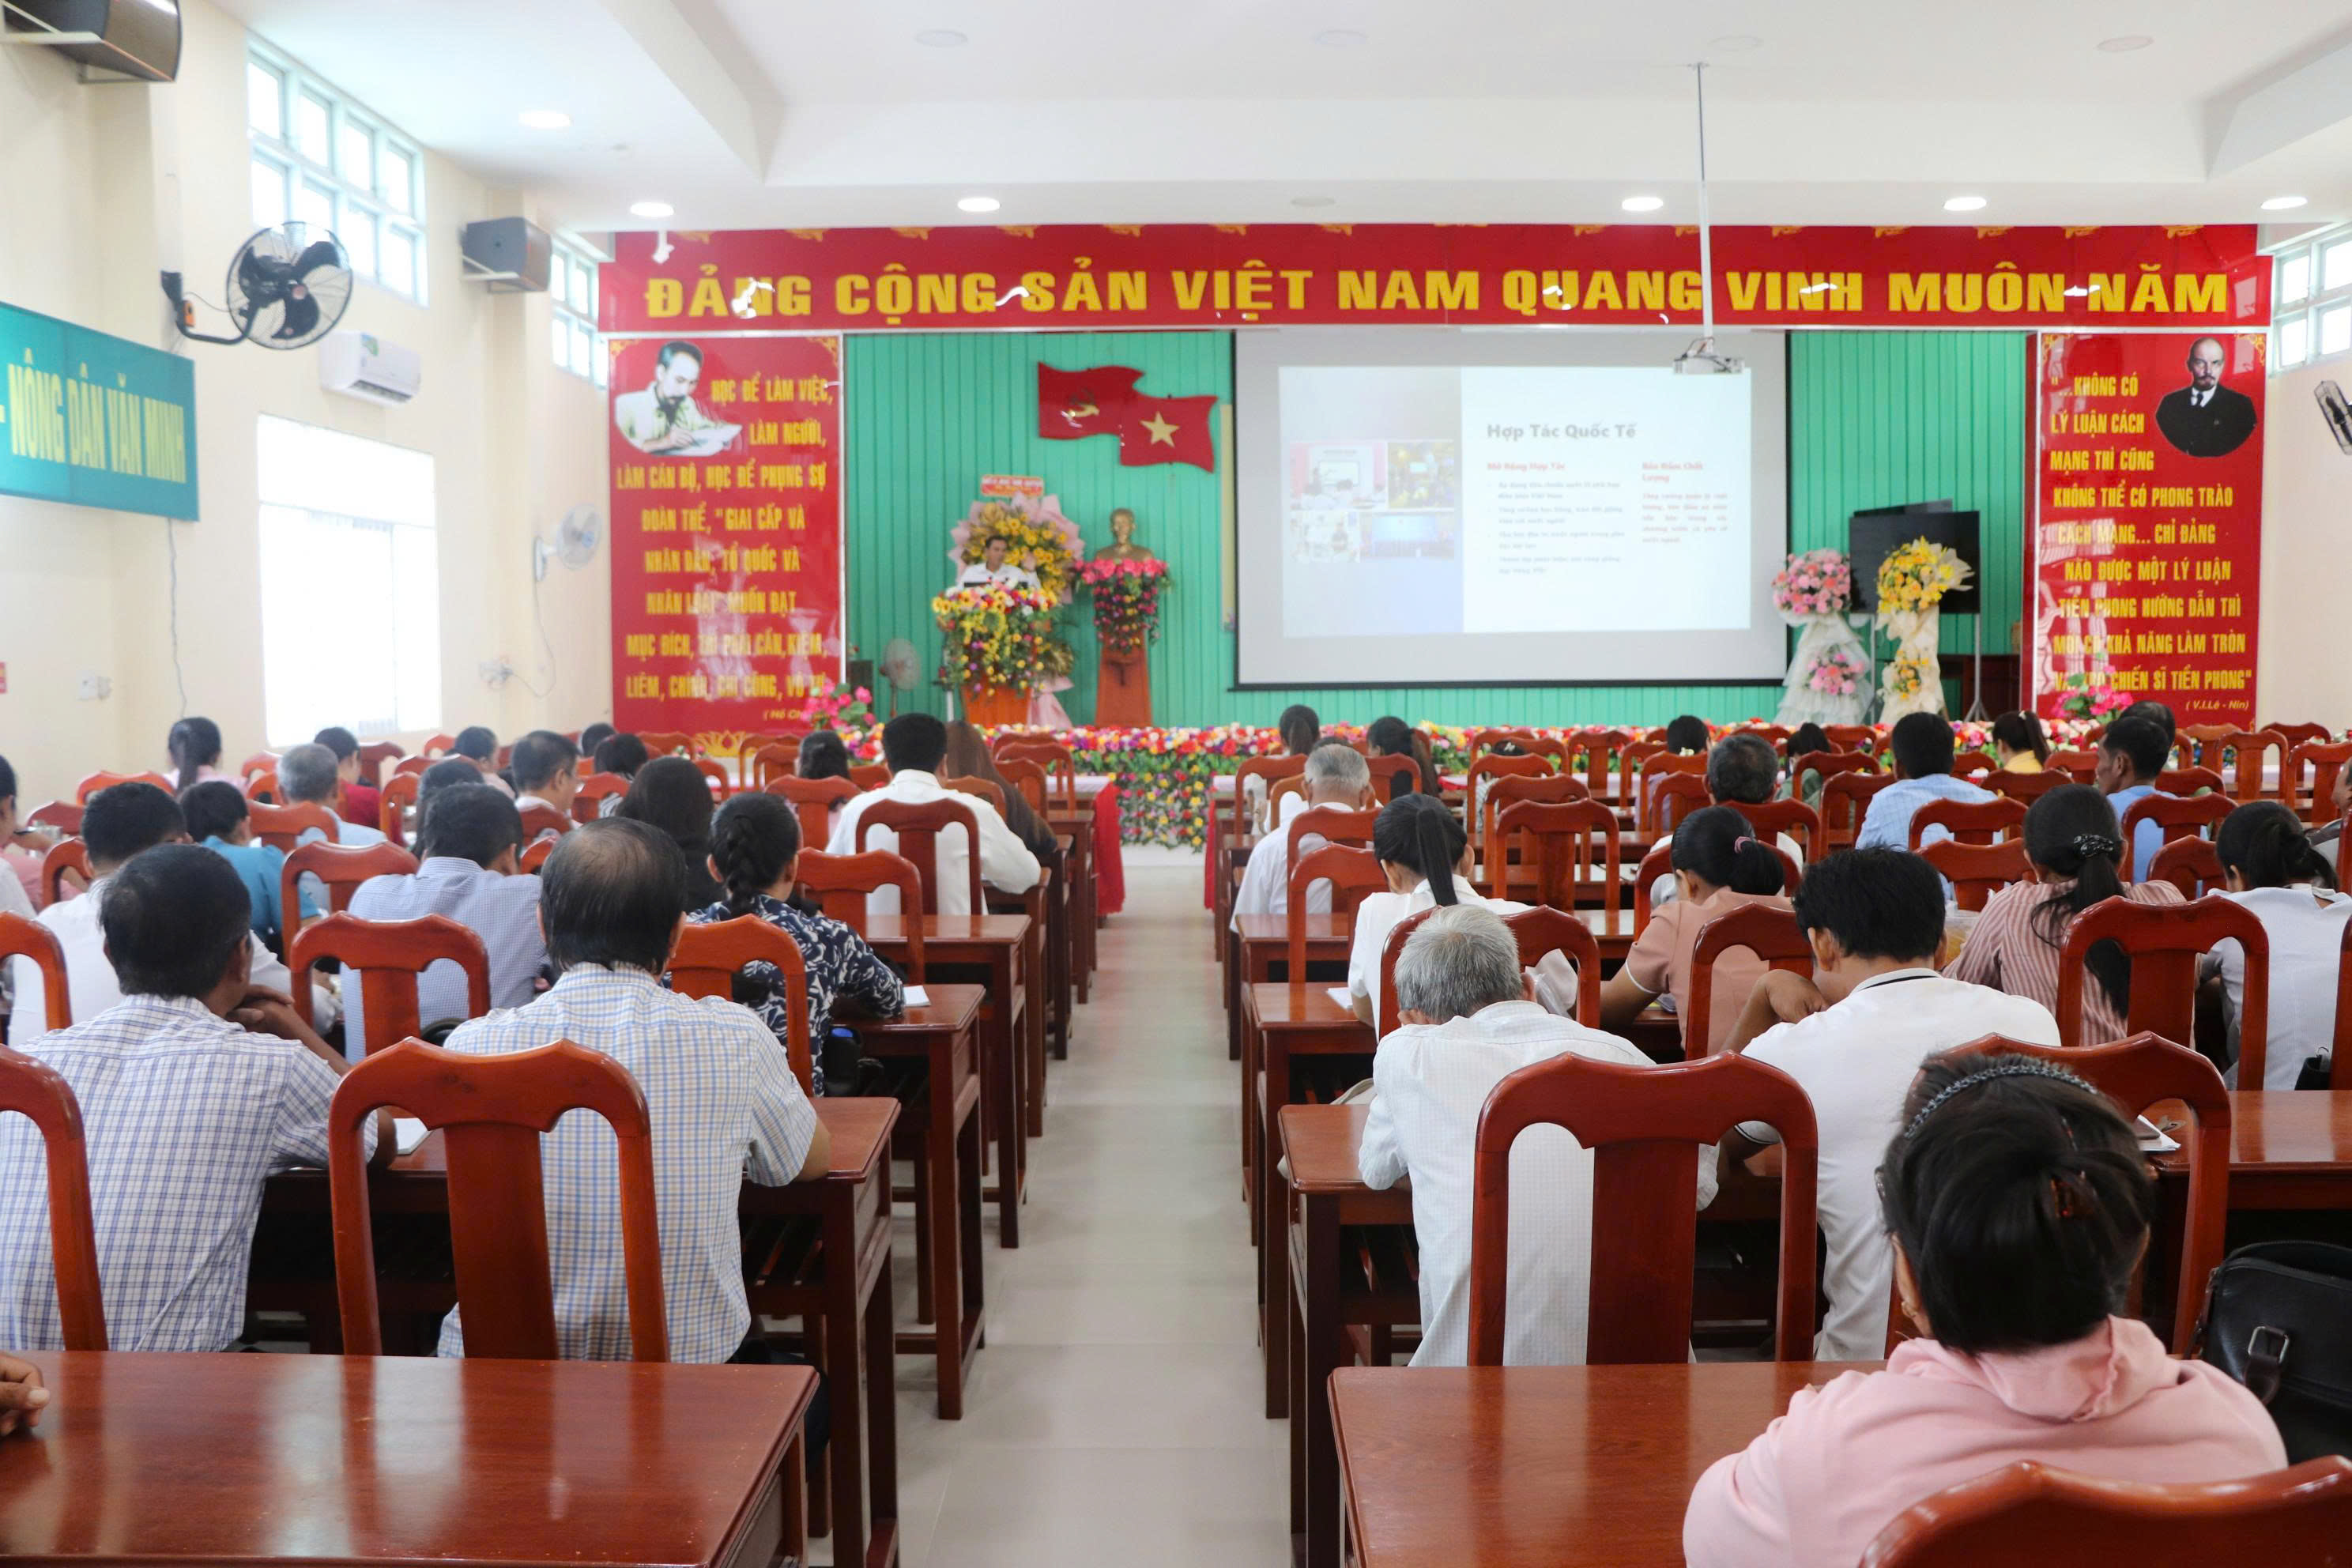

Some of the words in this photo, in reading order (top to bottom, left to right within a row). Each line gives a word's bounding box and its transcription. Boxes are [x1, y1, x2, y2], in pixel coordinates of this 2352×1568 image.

[646, 263, 811, 318] ĐẢNG
[835, 263, 996, 324] CỘNG
[1021, 257, 1146, 311] SẢN
[1171, 260, 1313, 321] VIỆT
[1337, 271, 1479, 310] NAM
[1503, 271, 1701, 315] QUANG
[1726, 271, 1862, 311] VINH
[1889, 262, 2064, 311] MUÔN
[2087, 263, 2226, 312] NĂM
[766, 375, 793, 402] LÀM
[2120, 371, 2139, 397] CÓ
[1487, 424, 1524, 442] Hợp
[1530, 424, 1559, 437] Tác
[1565, 420, 1609, 440] Quốc
[1615, 422, 1638, 437] Tế
[2052, 410, 2067, 433] LÝ
[2074, 409, 2107, 439] LUẬN
[2111, 409, 2144, 434] CÁCH
[2050, 450, 2089, 475] MẠNG
[2054, 483, 2095, 507] KHÔNG
[2101, 479, 2126, 507] THỂ
[2131, 483, 2147, 507] CÓ
[2152, 487, 2193, 507] PHONG
[2199, 484, 2233, 507] TRÀO
[2154, 518, 2176, 544] CHỈ
[2180, 518, 2216, 544] ĐẢNG
[2138, 556, 2167, 586] MỘT
[2173, 556, 2189, 581] LÝ
[2196, 556, 2231, 585] LUẬN
[2094, 597, 2137, 617] PHONG
[2106, 628, 2132, 654] KHẢ
[2137, 631, 2173, 654] NĂNG
[2177, 630, 2206, 654] LÀM
[2212, 629, 2245, 653] TRÒN
